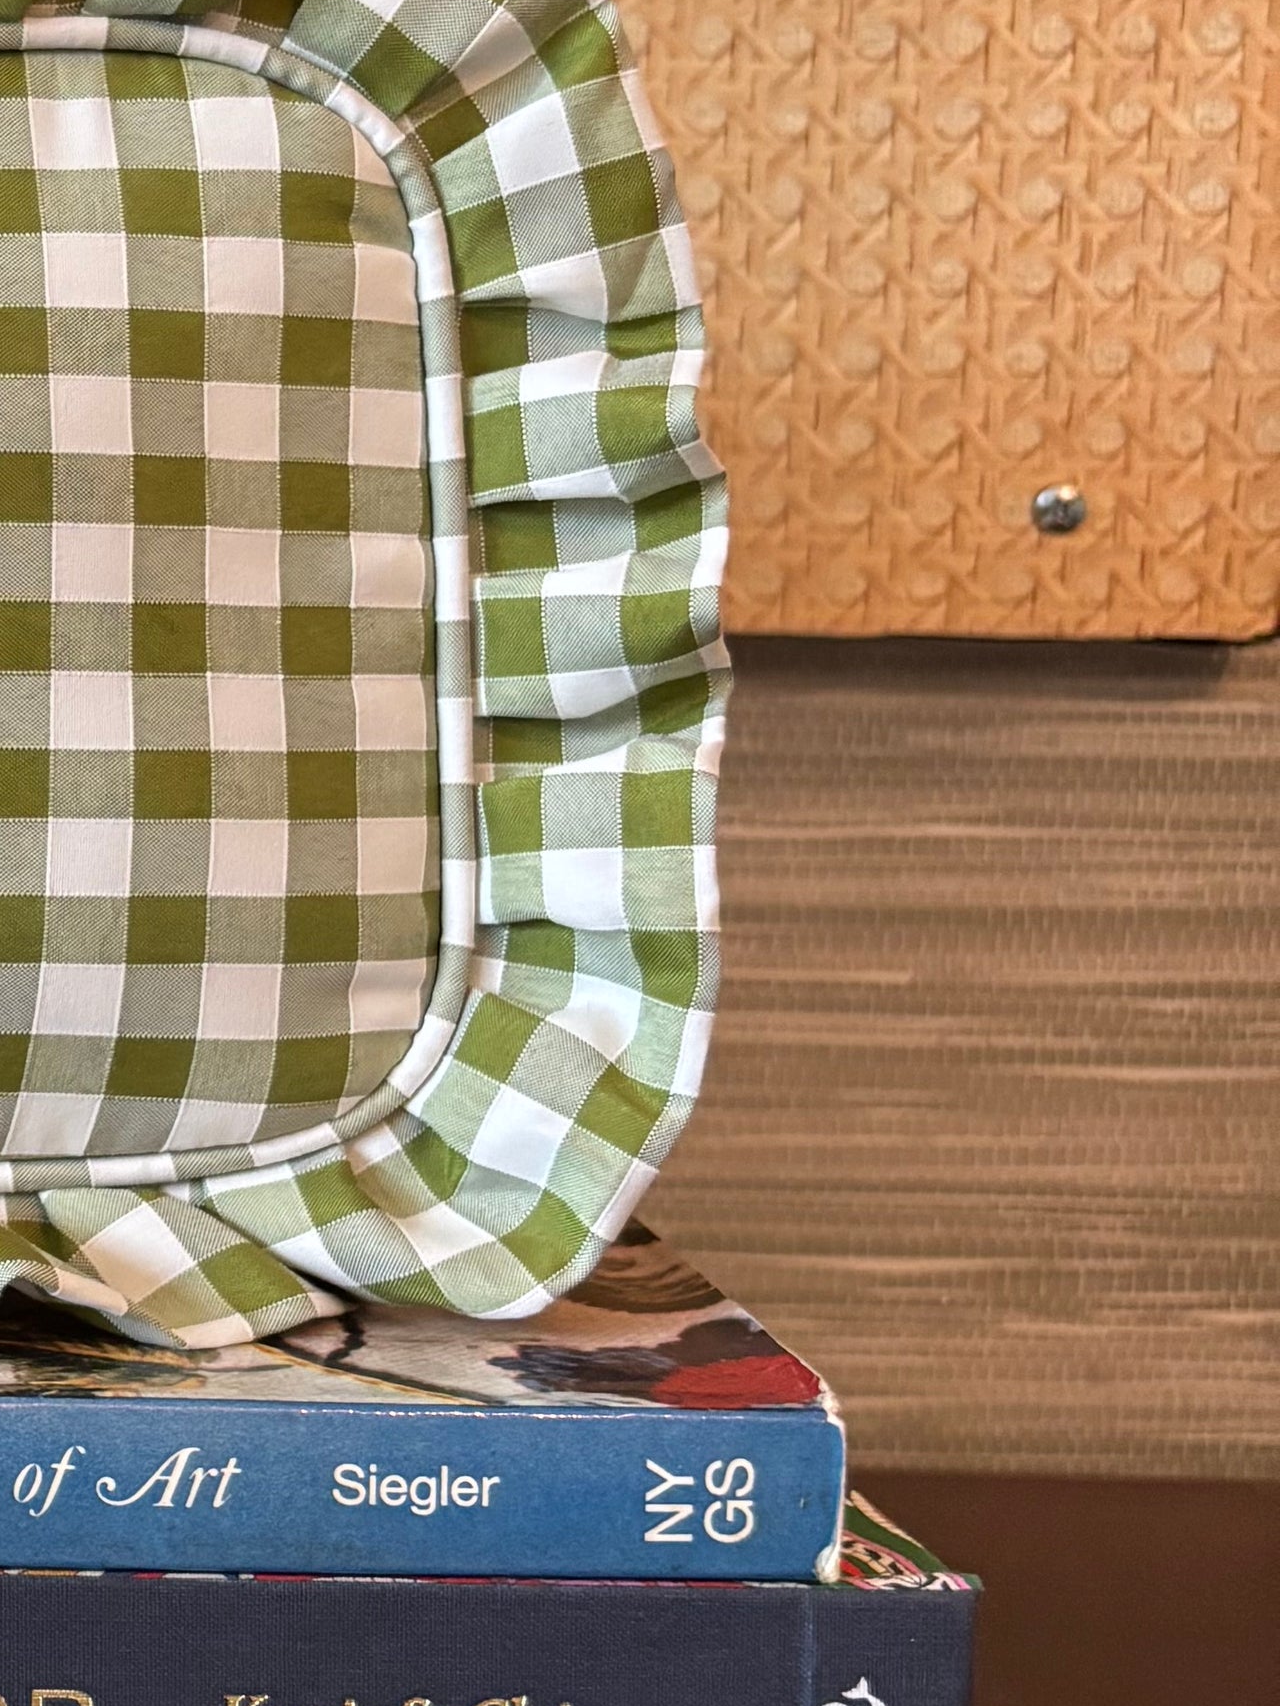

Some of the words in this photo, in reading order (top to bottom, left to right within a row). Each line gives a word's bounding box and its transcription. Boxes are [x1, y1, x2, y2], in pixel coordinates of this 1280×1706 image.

[13, 1446, 87, 1517] of
[95, 1446, 242, 1509] Art
[332, 1464, 501, 1516] Siegler
[644, 1459, 695, 1543] NY
[704, 1458, 755, 1544] GS
